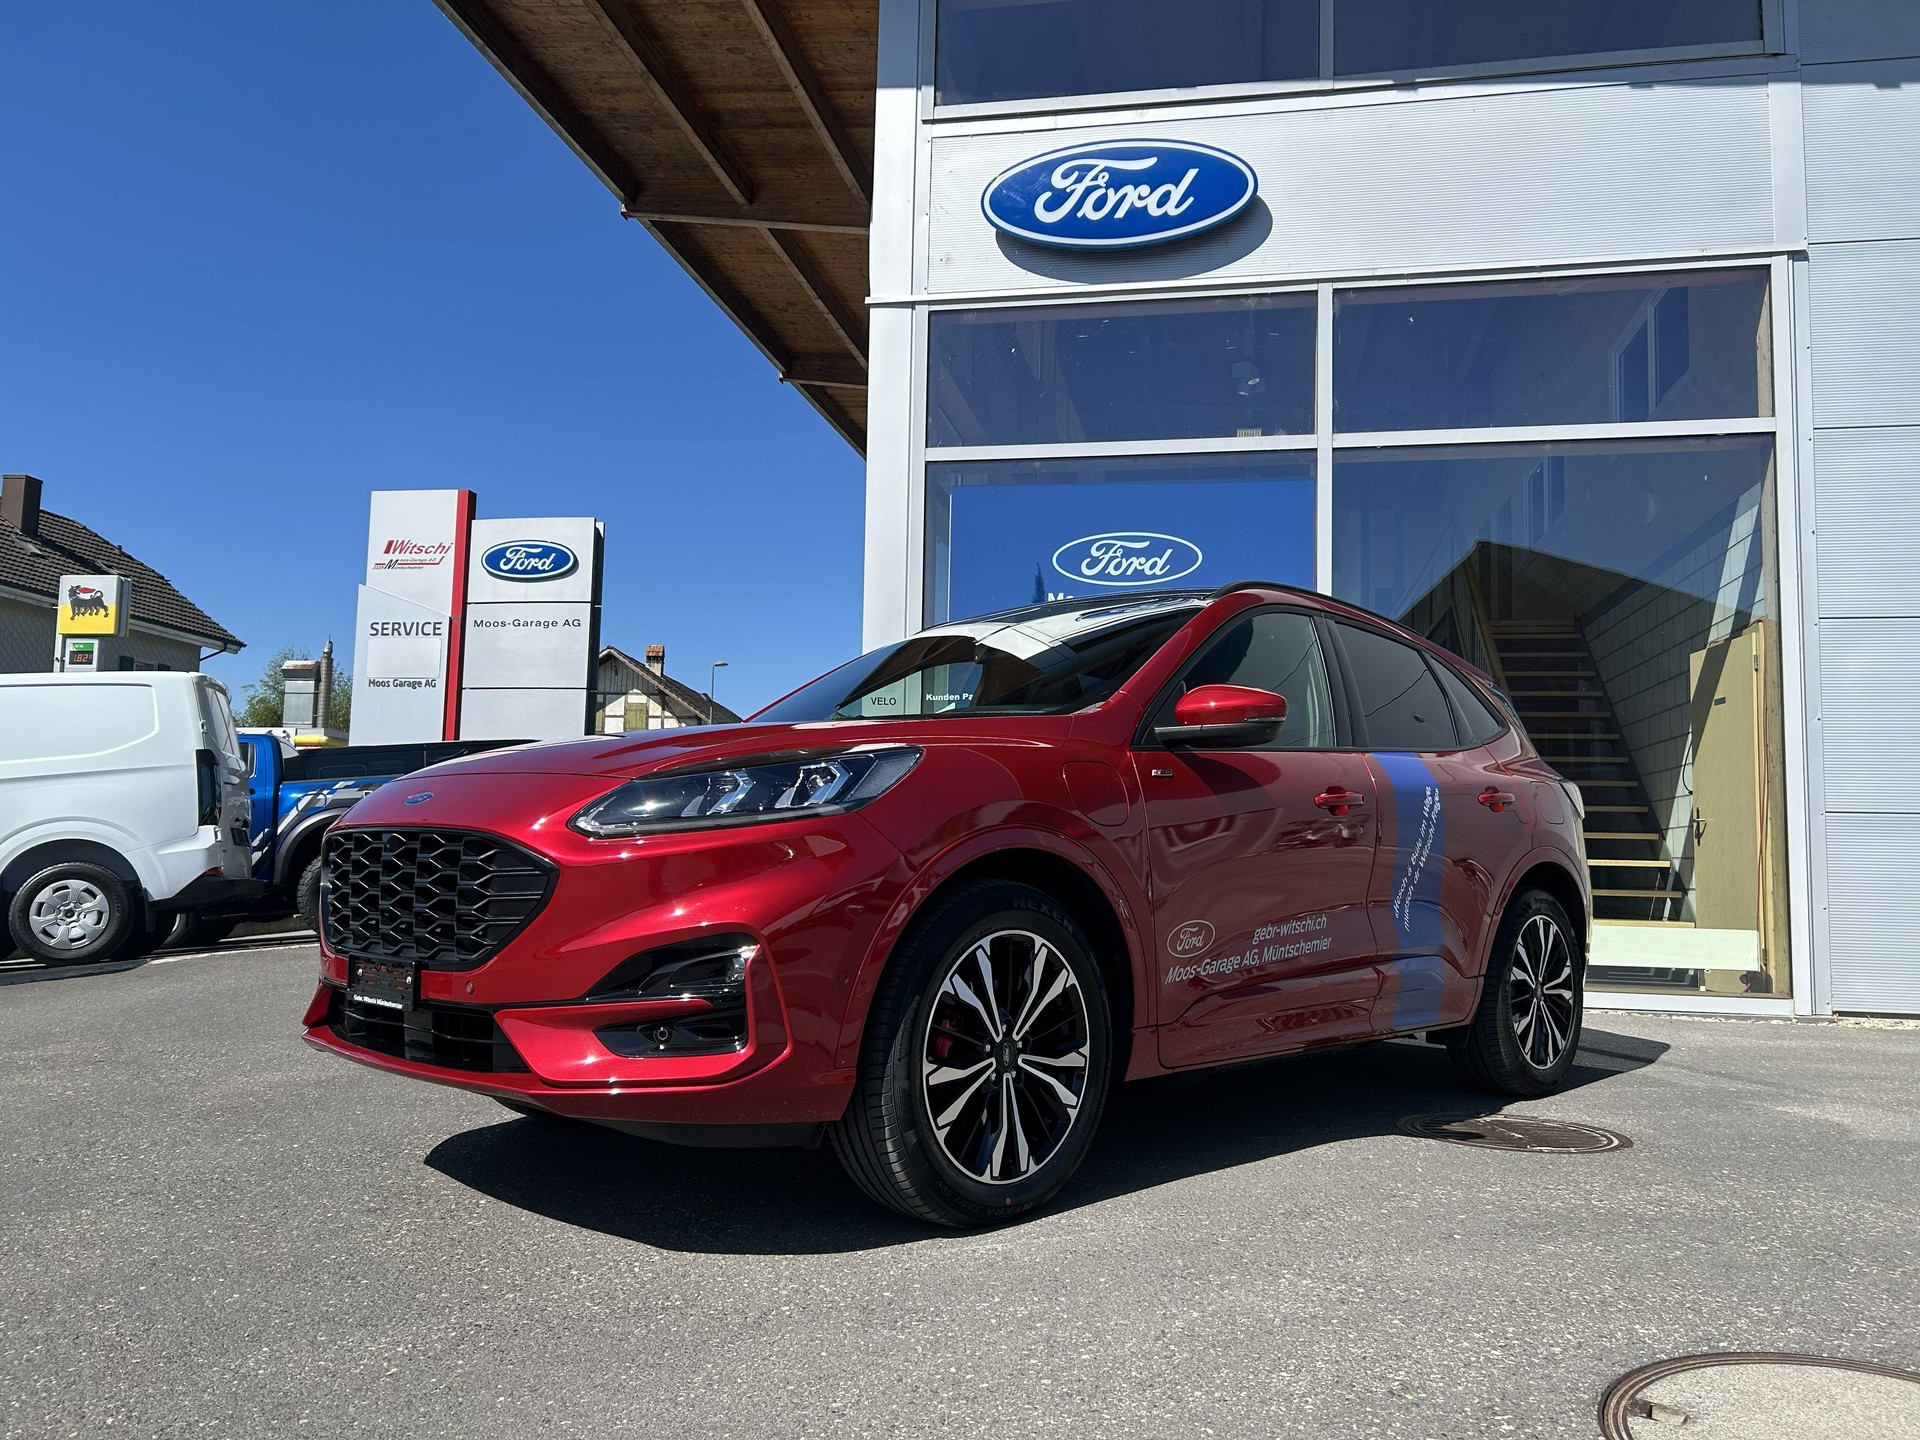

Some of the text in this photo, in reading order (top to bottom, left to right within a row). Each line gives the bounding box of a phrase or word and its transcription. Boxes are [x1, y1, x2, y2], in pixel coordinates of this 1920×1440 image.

[1034, 156, 1199, 223] Ford
[392, 540, 453, 554] Witschi
[500, 546, 557, 570] Ford
[1081, 540, 1173, 576] Ford
[369, 621, 443, 637] SERVICE
[473, 618, 581, 629] Moos-Garage AG
[368, 678, 437, 689] Moos Garage AG
[870, 697, 897, 706] VELO
[926, 693, 960, 701] Kunden
[1419, 821, 1435, 868] Witschi
[1012, 897, 1075, 934] NEXEN
[1176, 926, 1205, 951] Ford
[1252, 914, 1327, 945] gebr-witschi.ch
[1165, 936, 1332, 985] Moos-Garage AG, Müntschemier
